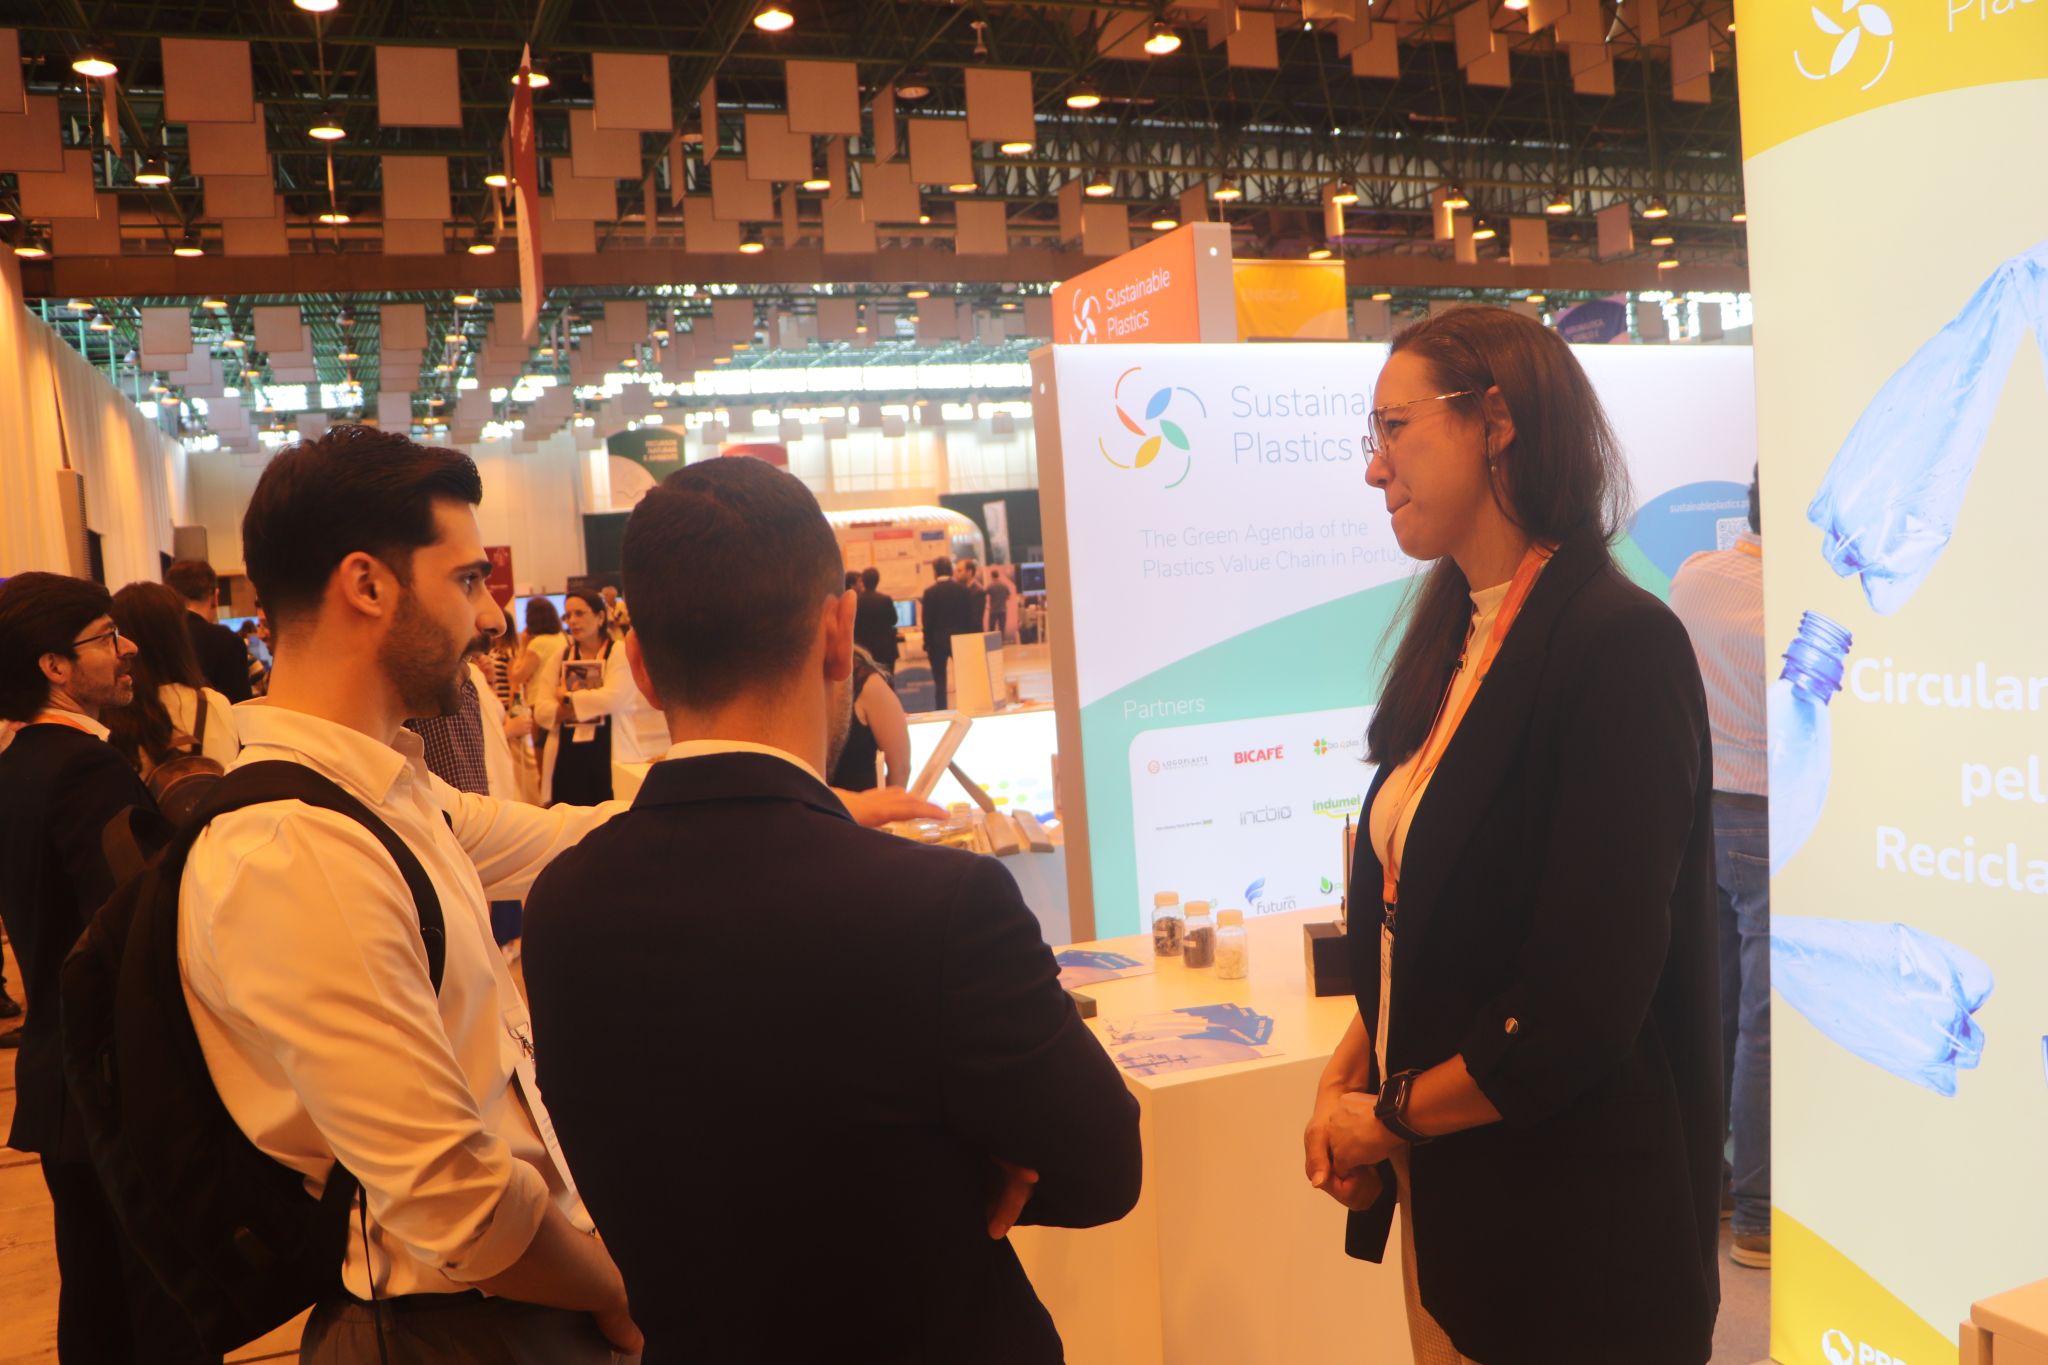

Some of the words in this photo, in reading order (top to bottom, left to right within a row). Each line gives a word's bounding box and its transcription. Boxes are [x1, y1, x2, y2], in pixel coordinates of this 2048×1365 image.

[1105, 268, 1171, 312] Sustainable
[1107, 308, 1150, 339] Plastics
[1233, 432, 1353, 464] Plastics
[1140, 529, 1177, 549] The
[1183, 526, 1239, 547] Green
[1244, 522, 1315, 546] Agenda
[1320, 519, 1337, 538] of
[1340, 518, 1369, 537] the
[1142, 557, 1215, 579] Plastics
[1219, 553, 1271, 574] Value
[1276, 549, 1327, 571] Chain
[1331, 547, 1347, 567] in
[1123, 696, 1206, 721] Partners
[1313, 795, 1360, 811] indumel
